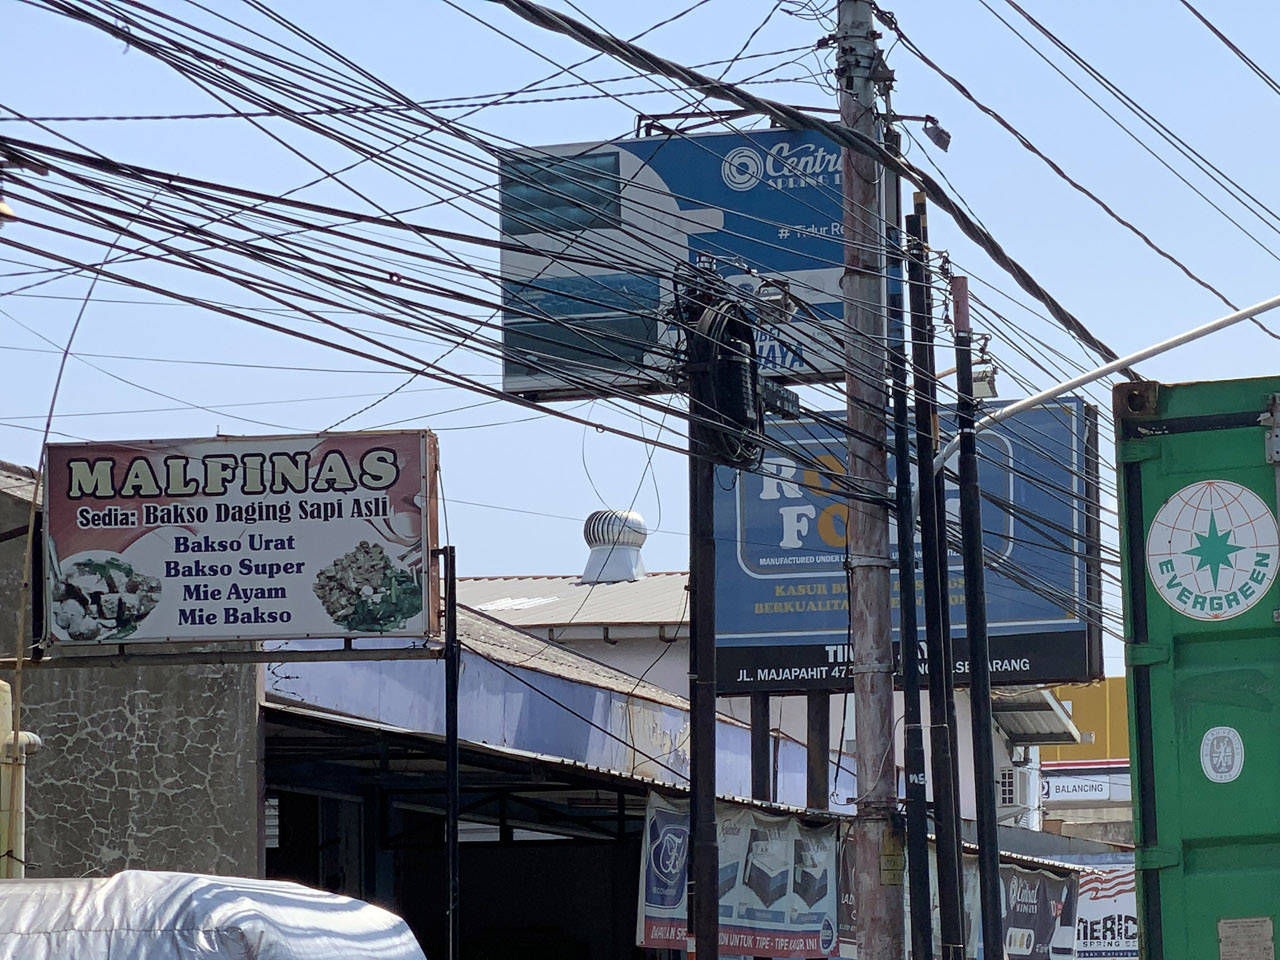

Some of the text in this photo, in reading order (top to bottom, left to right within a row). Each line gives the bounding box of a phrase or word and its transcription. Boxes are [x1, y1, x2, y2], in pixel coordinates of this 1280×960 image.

[67, 447, 399, 499] MALFINAS
[78, 496, 389, 527] Sedia: Bakso Daging Sapi Asli
[174, 534, 295, 553] Bakso Urat
[165, 558, 305, 580] Bakso Super
[759, 556, 815, 566] MANUFACTURED
[1158, 551, 1271, 612] EVERGREEN
[183, 584, 287, 605] Mie Ayam
[178, 607, 292, 626] Mie Bakso
[754, 600, 849, 614] BERKUALITA
[737, 670, 754, 682] JL.
[757, 666, 829, 681] MAJAPAHIT
[1055, 783, 1104, 794] BALANCING
